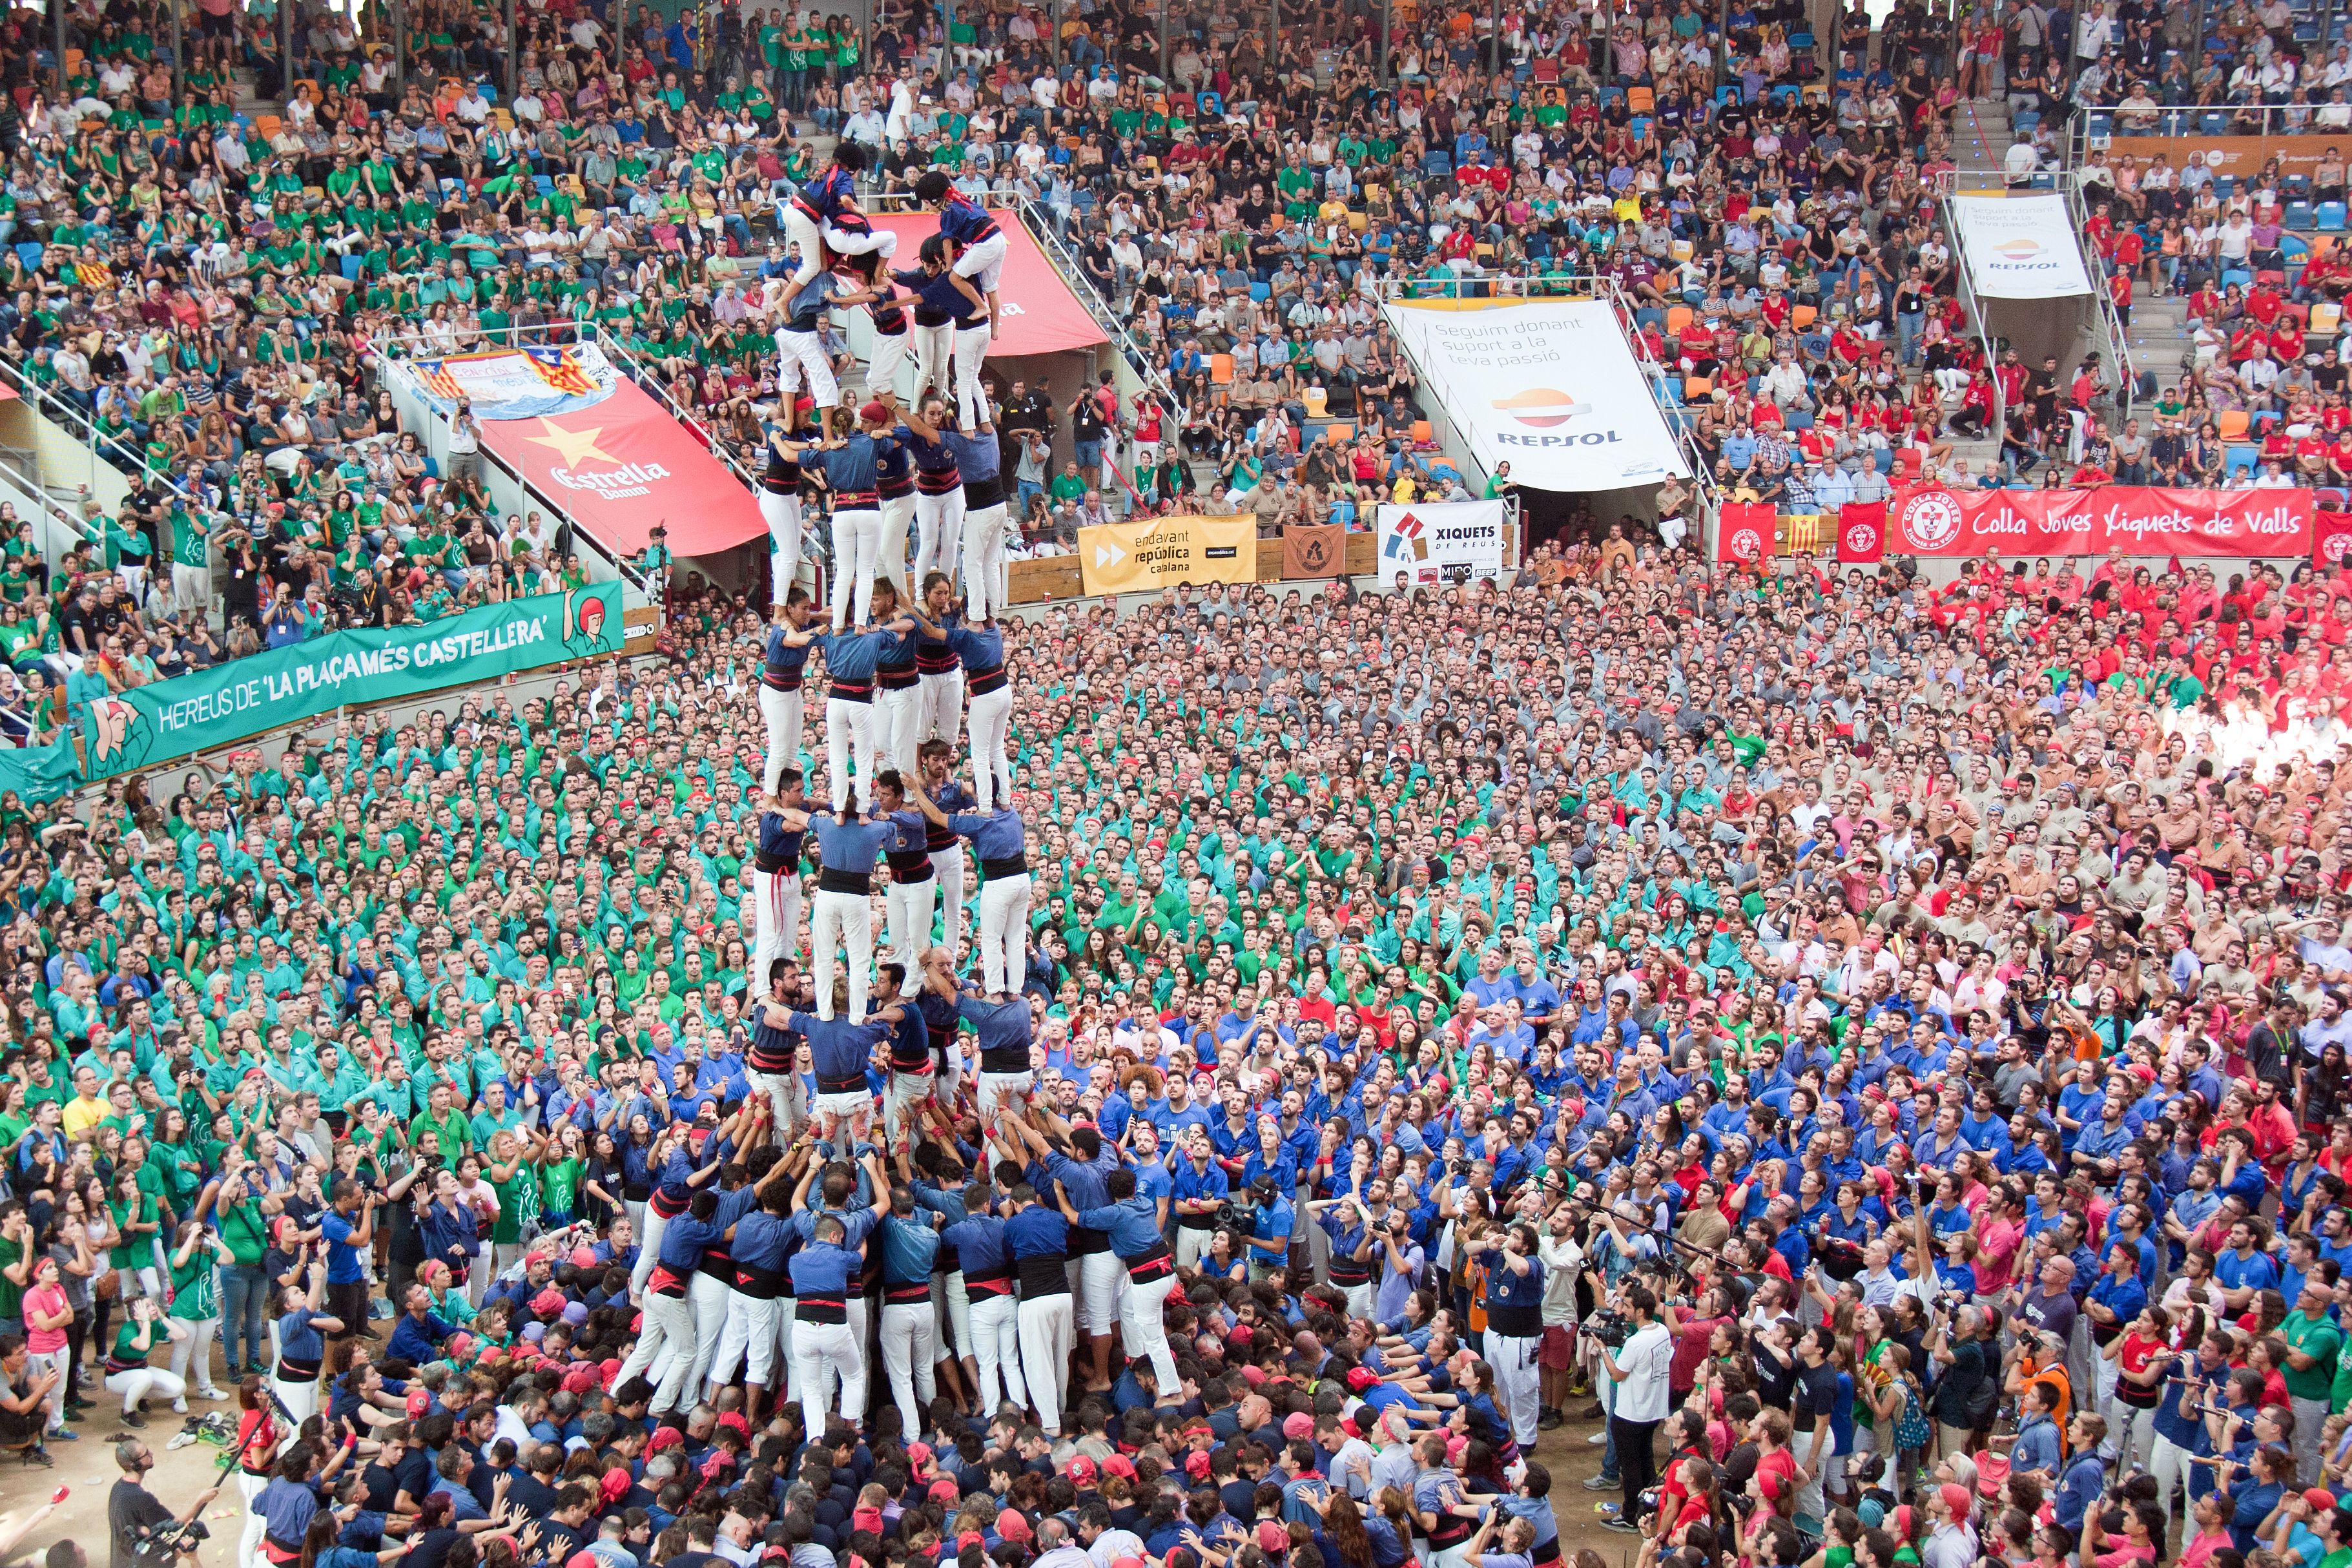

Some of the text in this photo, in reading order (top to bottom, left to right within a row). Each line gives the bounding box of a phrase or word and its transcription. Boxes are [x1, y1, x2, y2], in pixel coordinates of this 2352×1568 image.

[1435, 317, 1584, 340] Seguim donant
[1442, 336, 1547, 353] suport a la
[1449, 349, 1560, 368] teva passió
[1497, 430, 1623, 447] REPSOL
[550, 462, 670, 490] Estrella
[595, 486, 651, 500] Damm
[1904, 494, 1959, 523] COLLA JOVES
[1972, 503, 2302, 541] Colla Joves Xiquets de Valls
[1135, 530, 1189, 547] endavant
[1436, 526, 1495, 541] XIQUETS
[1906, 528, 1927, 547] Xiquets
[1939, 530, 1955, 544] Valls
[158, 688, 234, 733] HEREUS
[236, 679, 261, 711] DE
